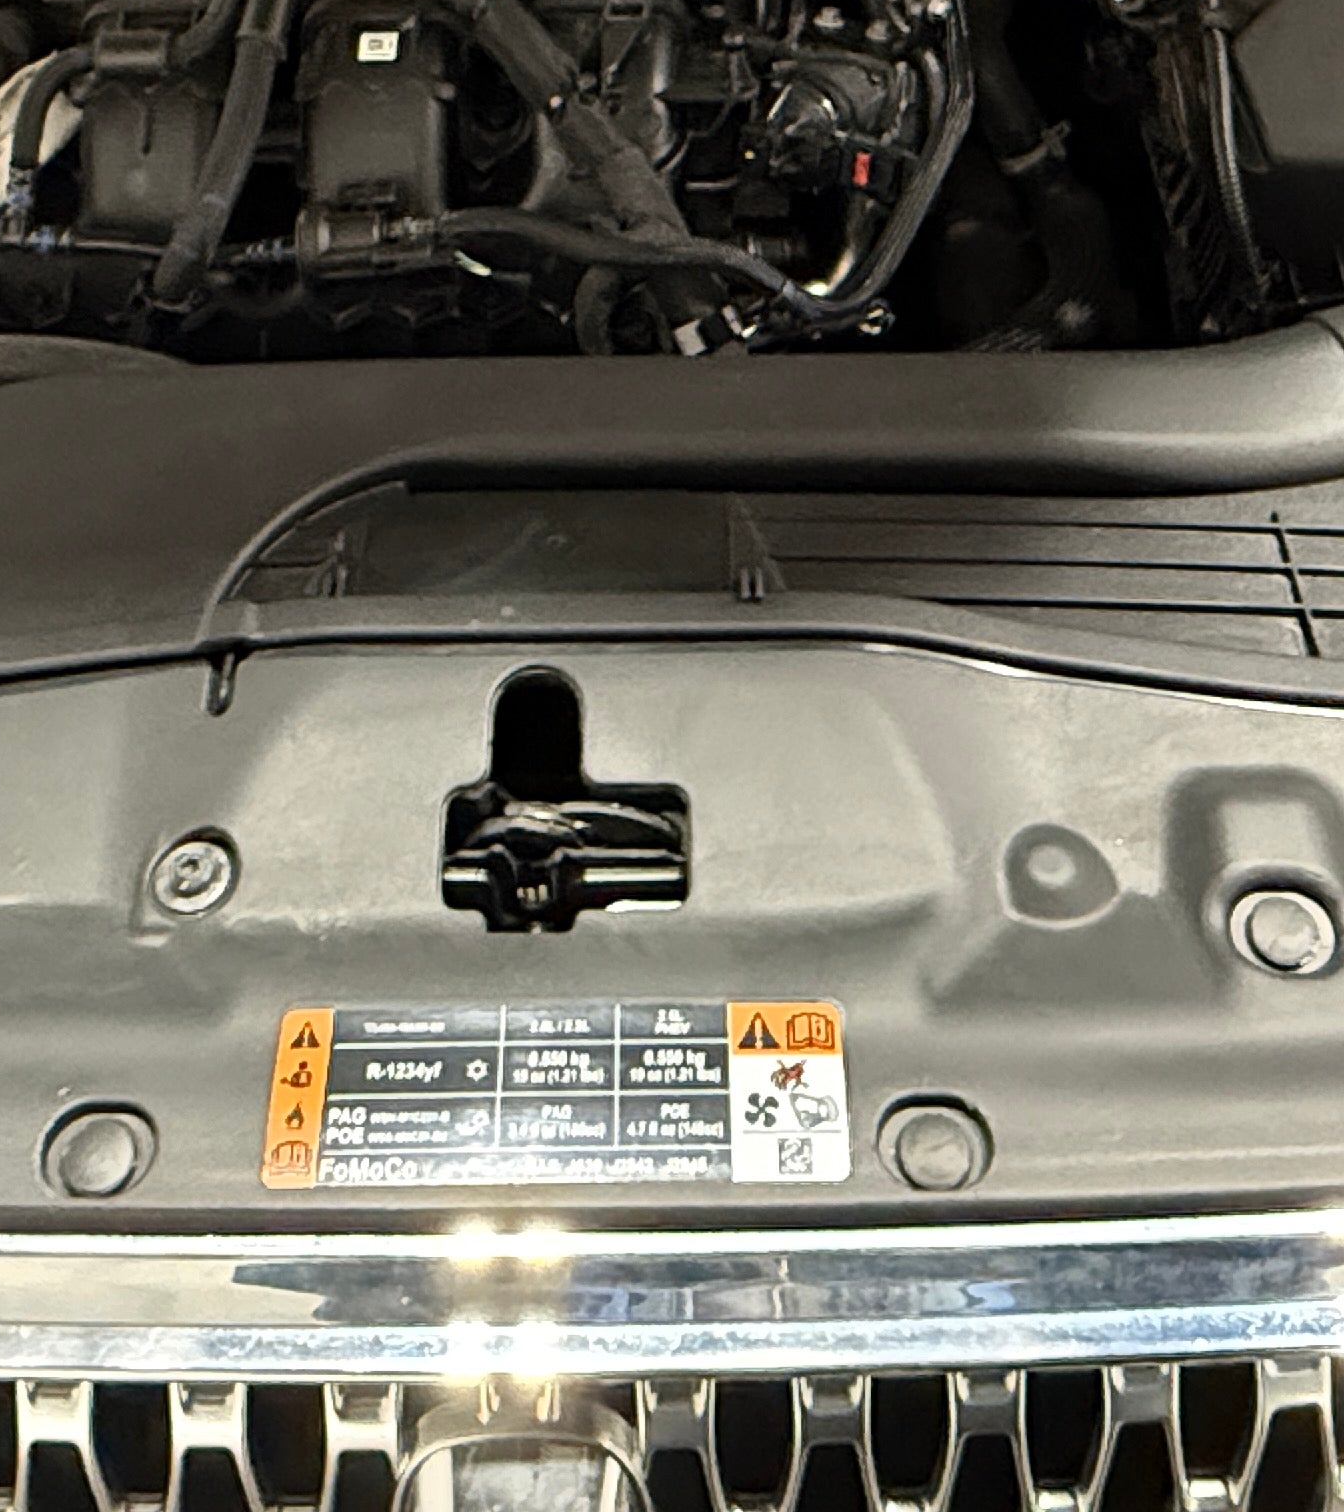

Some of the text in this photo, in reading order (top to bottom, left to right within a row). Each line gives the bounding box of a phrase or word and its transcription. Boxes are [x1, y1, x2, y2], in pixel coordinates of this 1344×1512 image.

[570, 1050, 590, 1068] kg
[686, 1049, 706, 1068] kg
[366, 1060, 444, 1083] R-1234yf
[328, 1106, 368, 1126] PAG
[660, 1103, 690, 1119] POE
[326, 1126, 365, 1145] POE
[319, 1157, 418, 1182] FoMoCo
